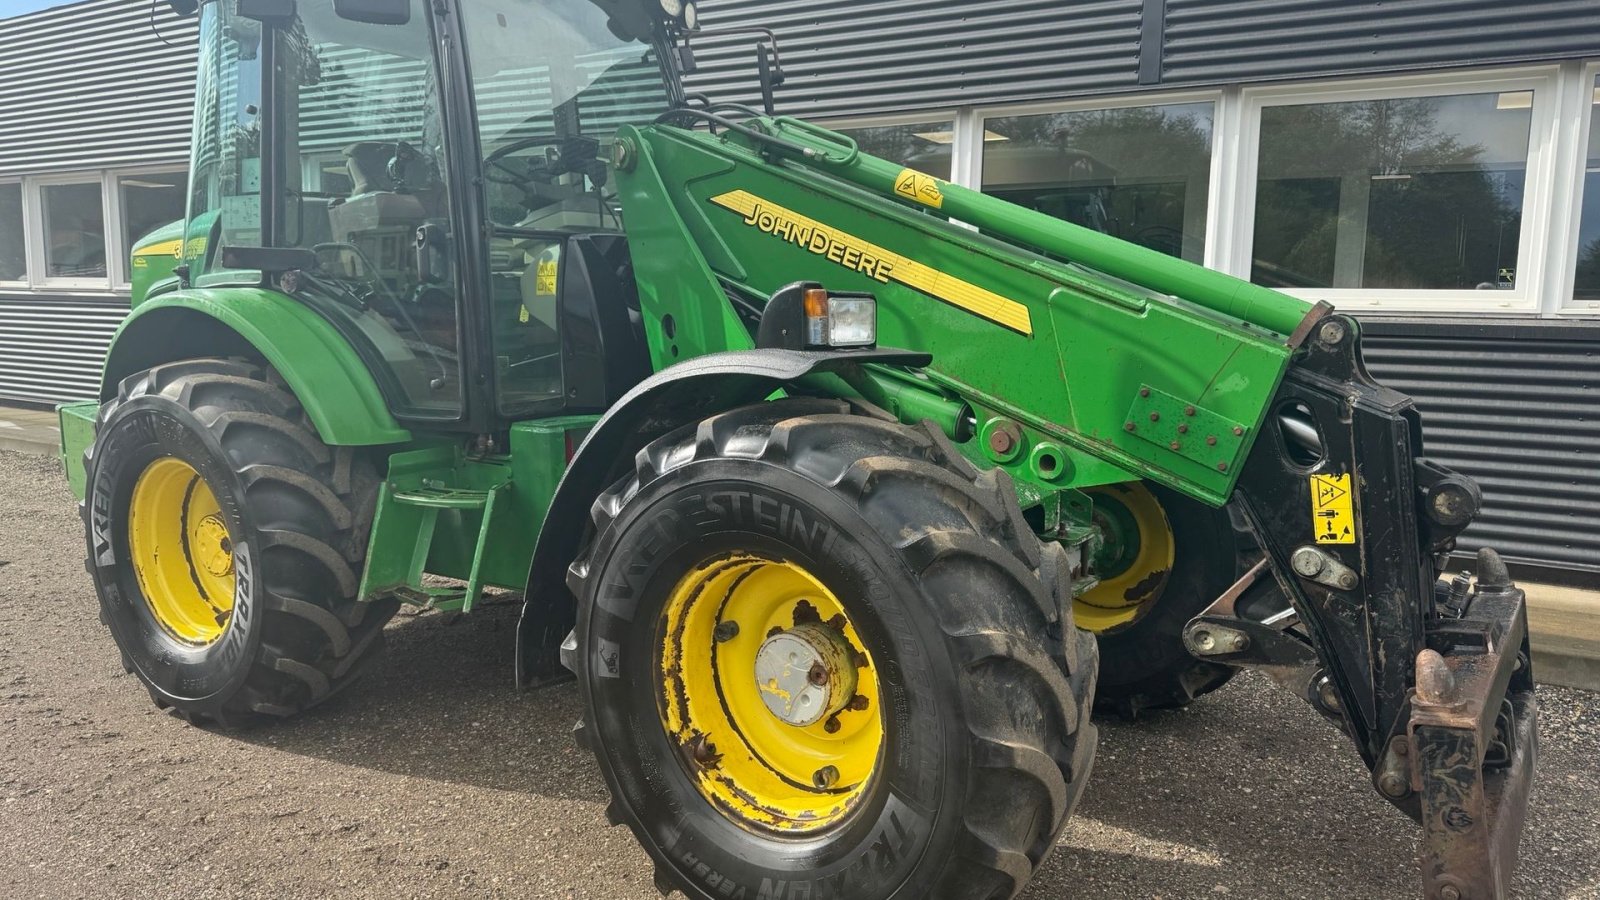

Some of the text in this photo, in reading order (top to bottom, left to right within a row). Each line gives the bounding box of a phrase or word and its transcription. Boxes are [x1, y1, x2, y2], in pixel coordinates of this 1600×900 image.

[744, 204, 894, 284] JOHN DEERE
[94, 413, 158, 558] VREDESEIN
[219, 551, 250, 668] TRAXIO
